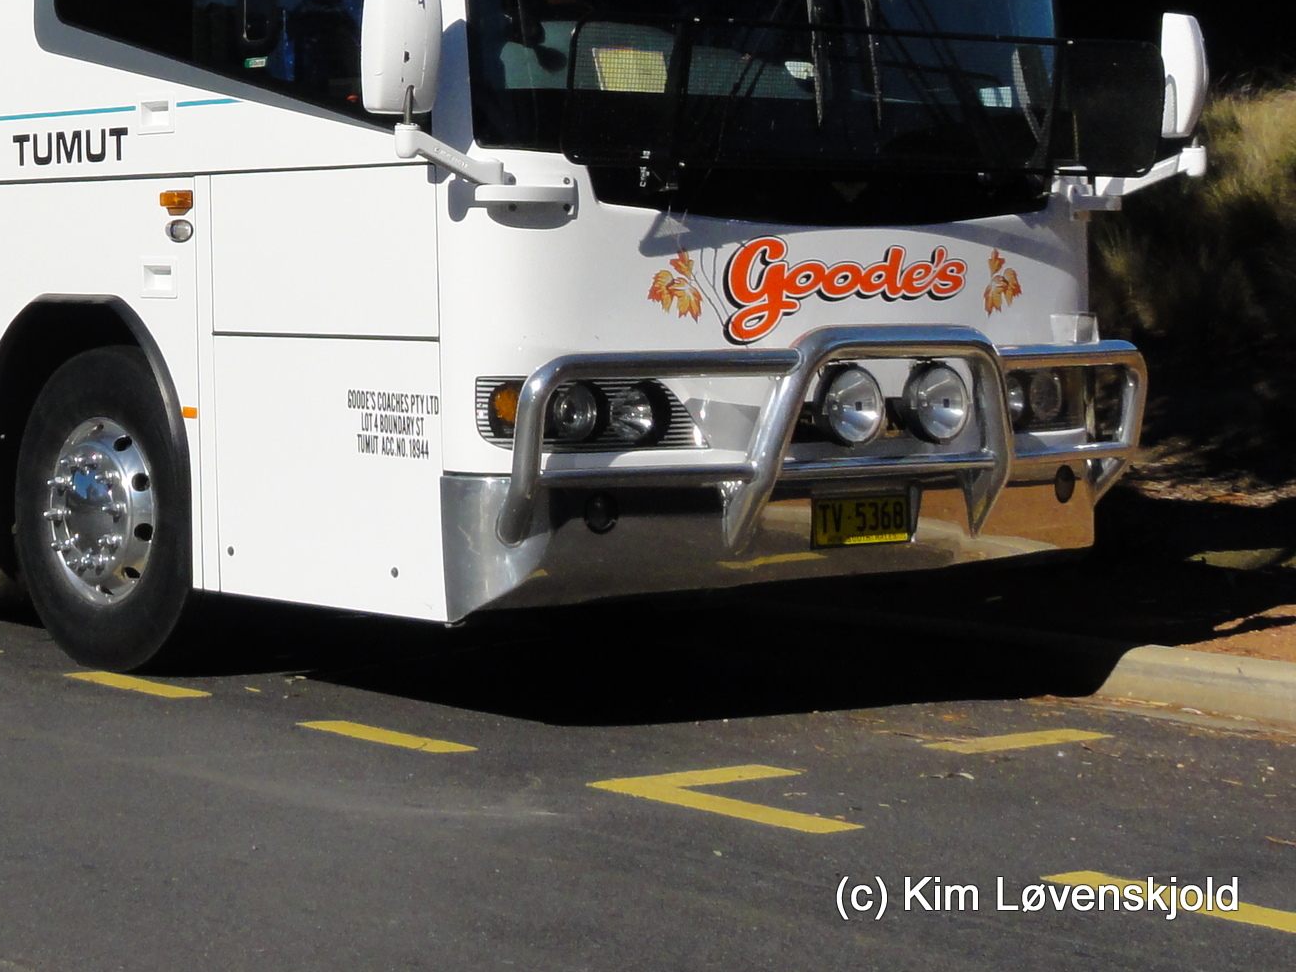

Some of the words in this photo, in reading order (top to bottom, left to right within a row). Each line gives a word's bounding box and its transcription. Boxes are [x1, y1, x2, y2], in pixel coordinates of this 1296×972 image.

[13, 127, 128, 166] TUMUT
[722, 235, 968, 346] Goode's
[347, 389, 376, 410] GOODE'S
[377, 391, 409, 414] COACHES
[410, 394, 425, 415] PTY
[426, 395, 440, 416] LTD
[361, 412, 372, 432] LOT
[373, 414, 379, 432] 4
[380, 414, 415, 436] BOUNDARY
[415, 417, 425, 437] ST
[357, 434, 379, 454] TUMUT
[409, 439, 430, 460] 18944
[818, 503, 843, 534] TV
[855, 502, 904, 532] 5368
